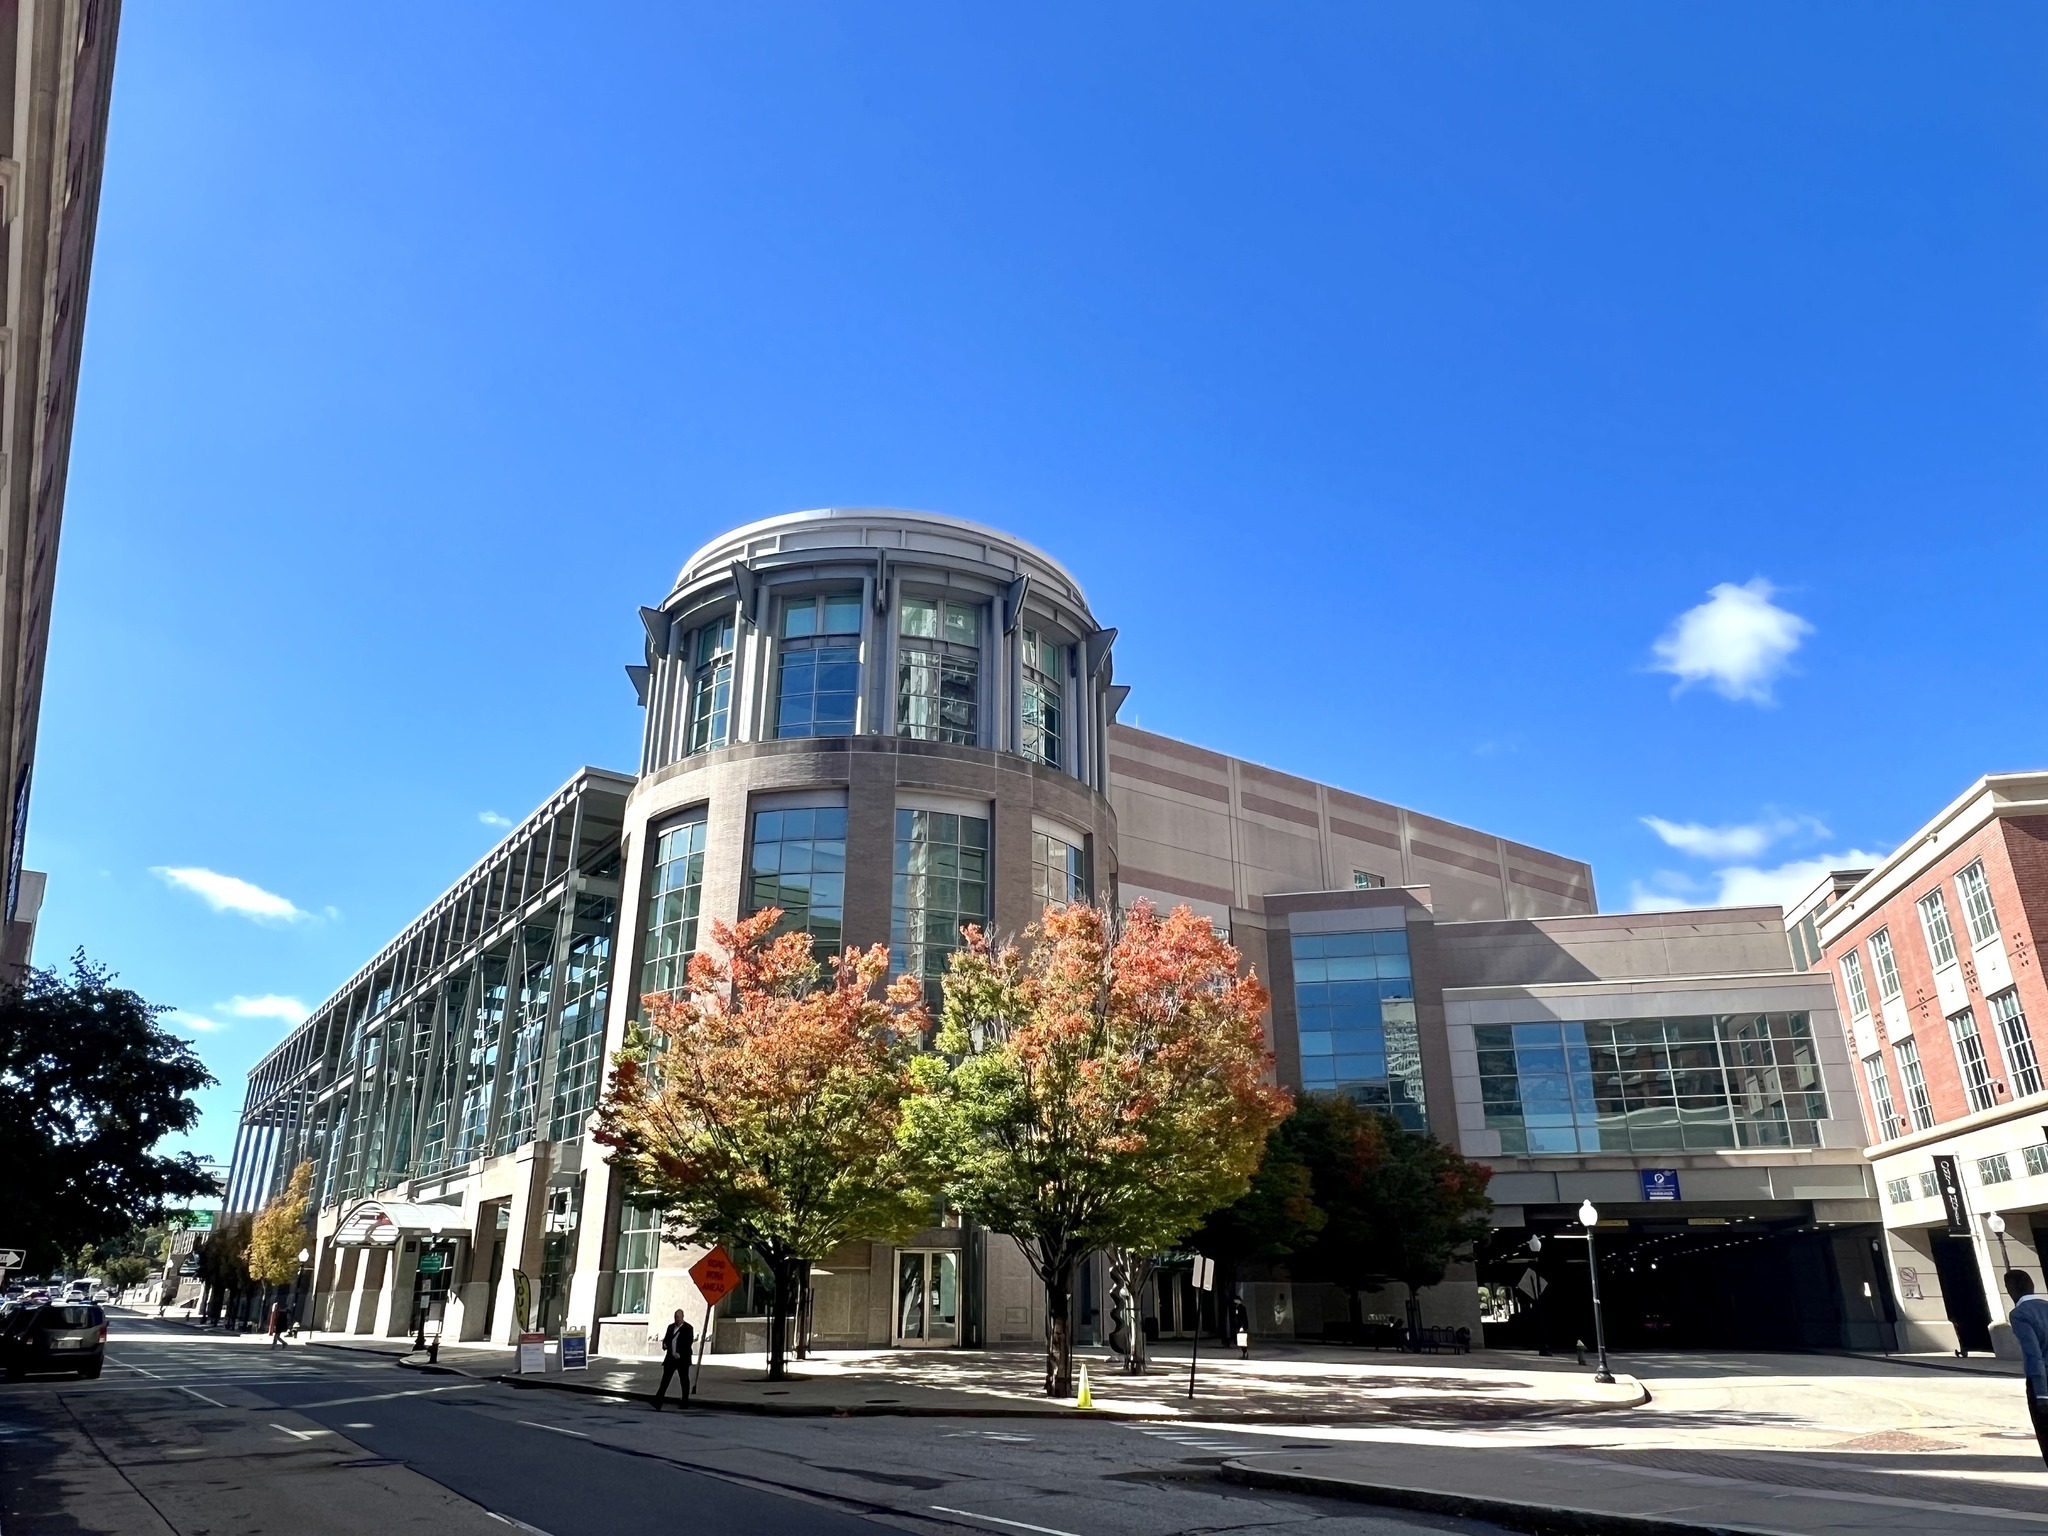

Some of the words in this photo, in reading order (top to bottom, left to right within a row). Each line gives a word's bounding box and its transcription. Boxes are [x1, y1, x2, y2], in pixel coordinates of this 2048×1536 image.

[707, 1258, 726, 1269] ROAD
[705, 1270, 724, 1280] WORK
[702, 1282, 725, 1294] AHEAD
